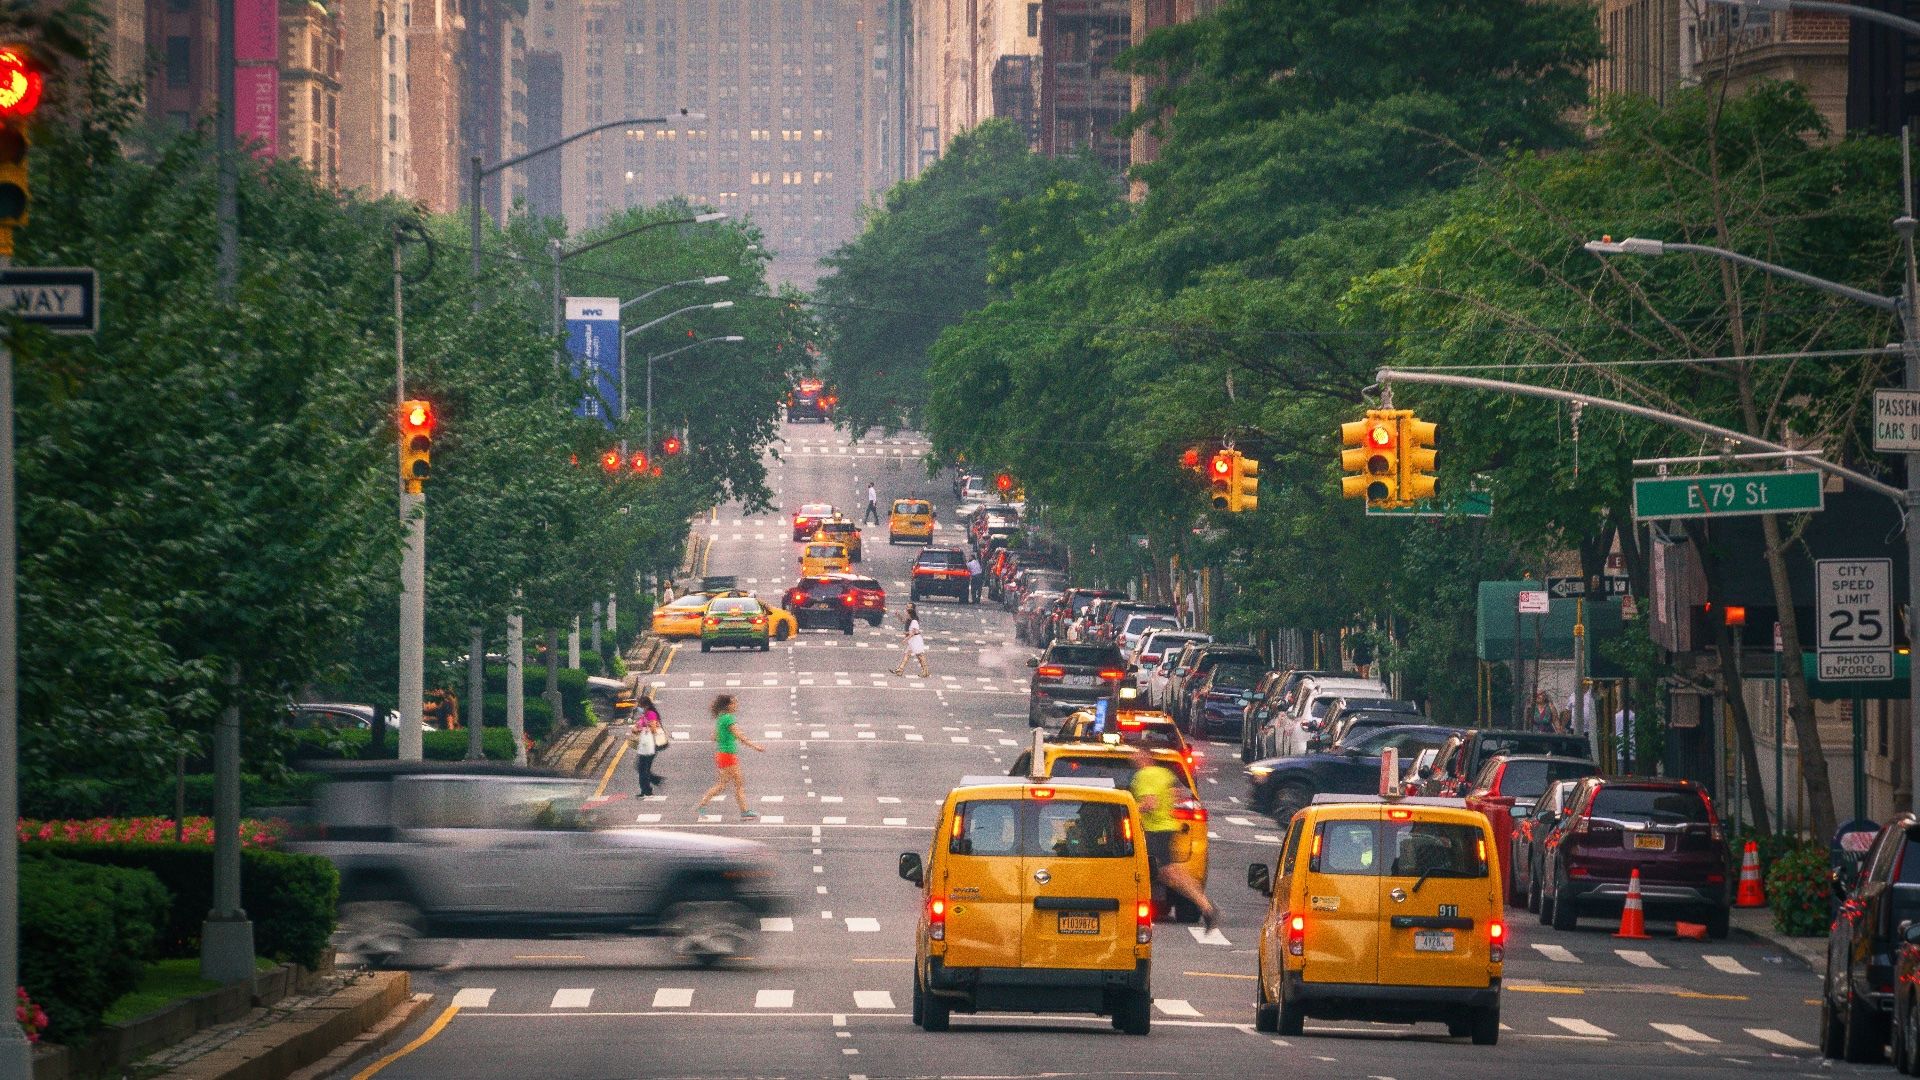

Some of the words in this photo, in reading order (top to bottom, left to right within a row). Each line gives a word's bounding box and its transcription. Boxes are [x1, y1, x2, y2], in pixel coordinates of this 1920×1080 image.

[12, 288, 70, 312] WAY
[582, 308, 603, 316] NYC
[1879, 398, 1920, 416] PASSEN
[1878, 422, 1905, 440] CARS
[1687, 485, 1700, 508] E
[1709, 482, 1735, 507] 79
[1746, 482, 1768, 504] St
[1838, 566, 1867, 577] CITY
[1557, 583, 1577, 593] ONE
[1832, 580, 1874, 590] SPEED
[1837, 594, 1870, 604] LIMIT
[1829, 608, 1883, 641] 25
[1837, 655, 1874, 665] PHOTO
[1826, 665, 1886, 675] ENFORCED
[1439, 905, 1458, 917] 911
